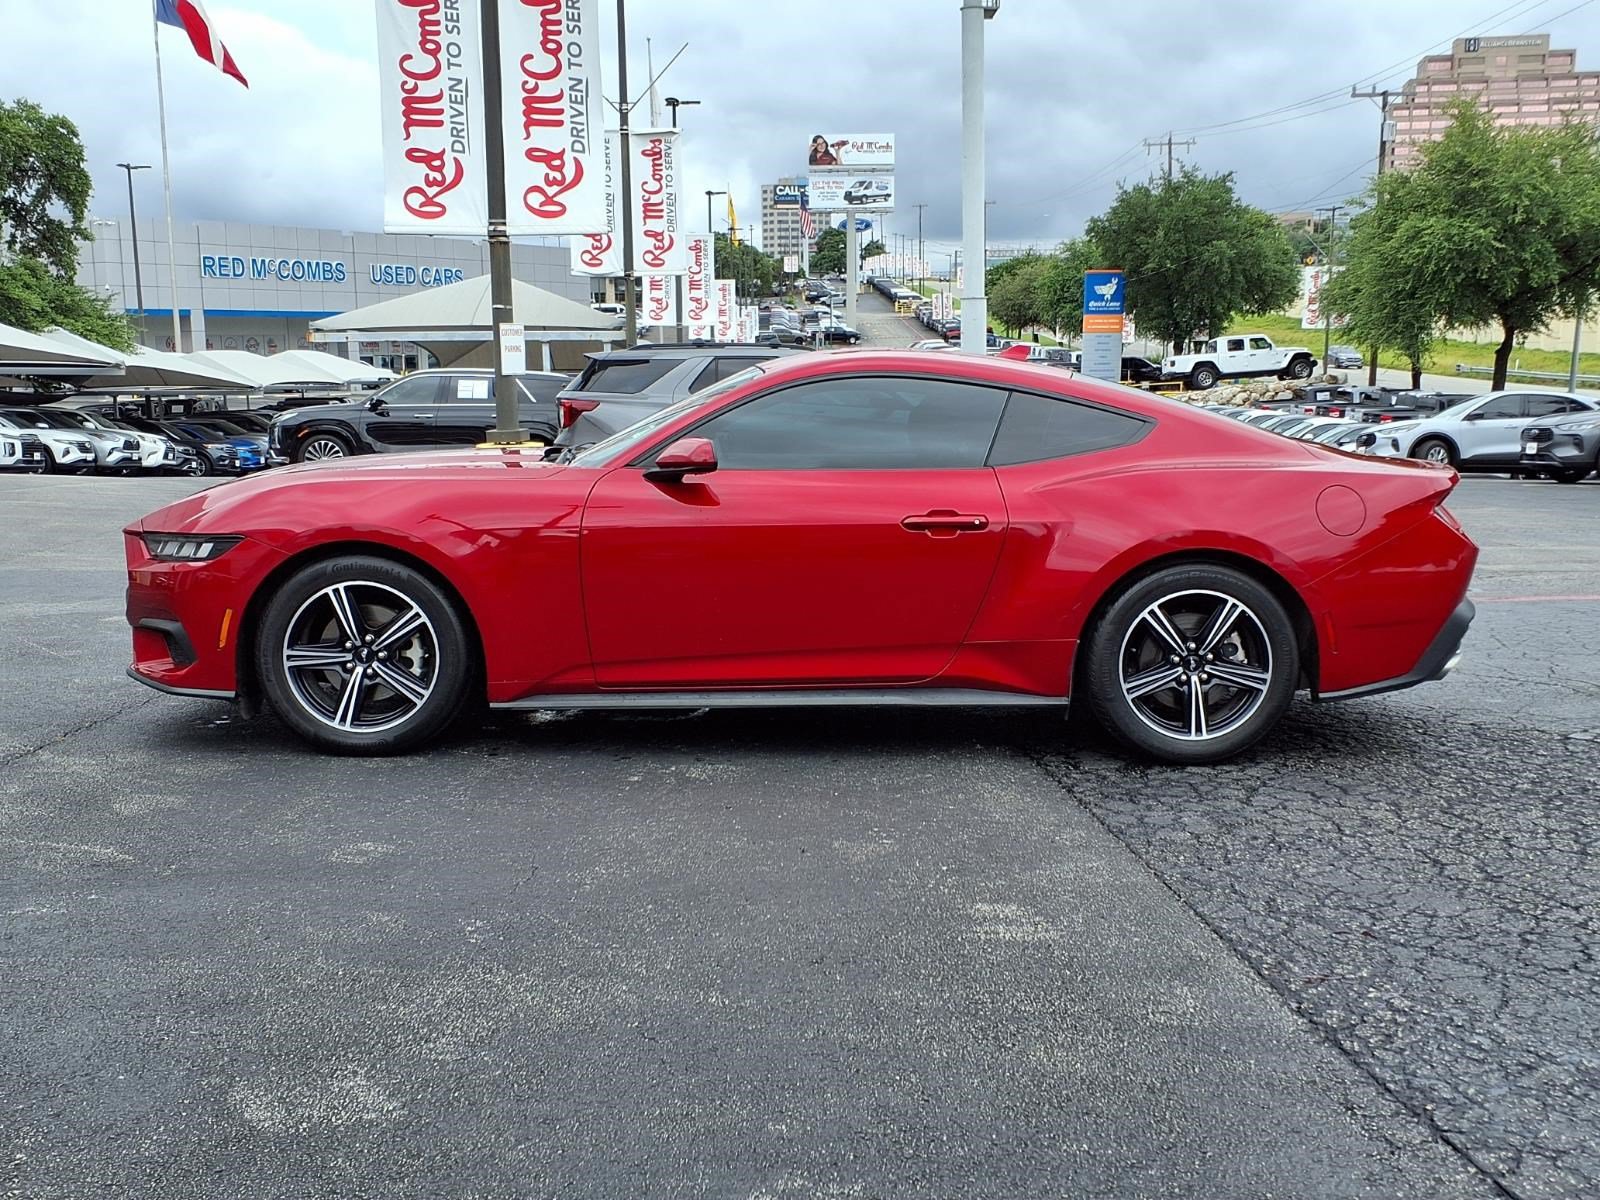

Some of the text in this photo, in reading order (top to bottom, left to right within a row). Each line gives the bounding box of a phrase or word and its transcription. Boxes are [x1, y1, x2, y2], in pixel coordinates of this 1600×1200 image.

[398, 0, 464, 219] Red McCom
[444, 0, 467, 154] DRIVEN TO SER
[520, 0, 584, 219] Red McCom
[565, 0, 587, 154] DRIVEN TO SER
[640, 138, 664, 226] McCombs
[664, 137, 676, 233] DRIVEN TO SERVE
[201, 255, 246, 278] RED
[369, 263, 417, 286] USED
[420, 266, 464, 288] CARS
[642, 229, 675, 268] Red
[687, 239, 708, 321] Red McCombs
[703, 262, 709, 271] TO
[649, 296, 669, 321] Red
